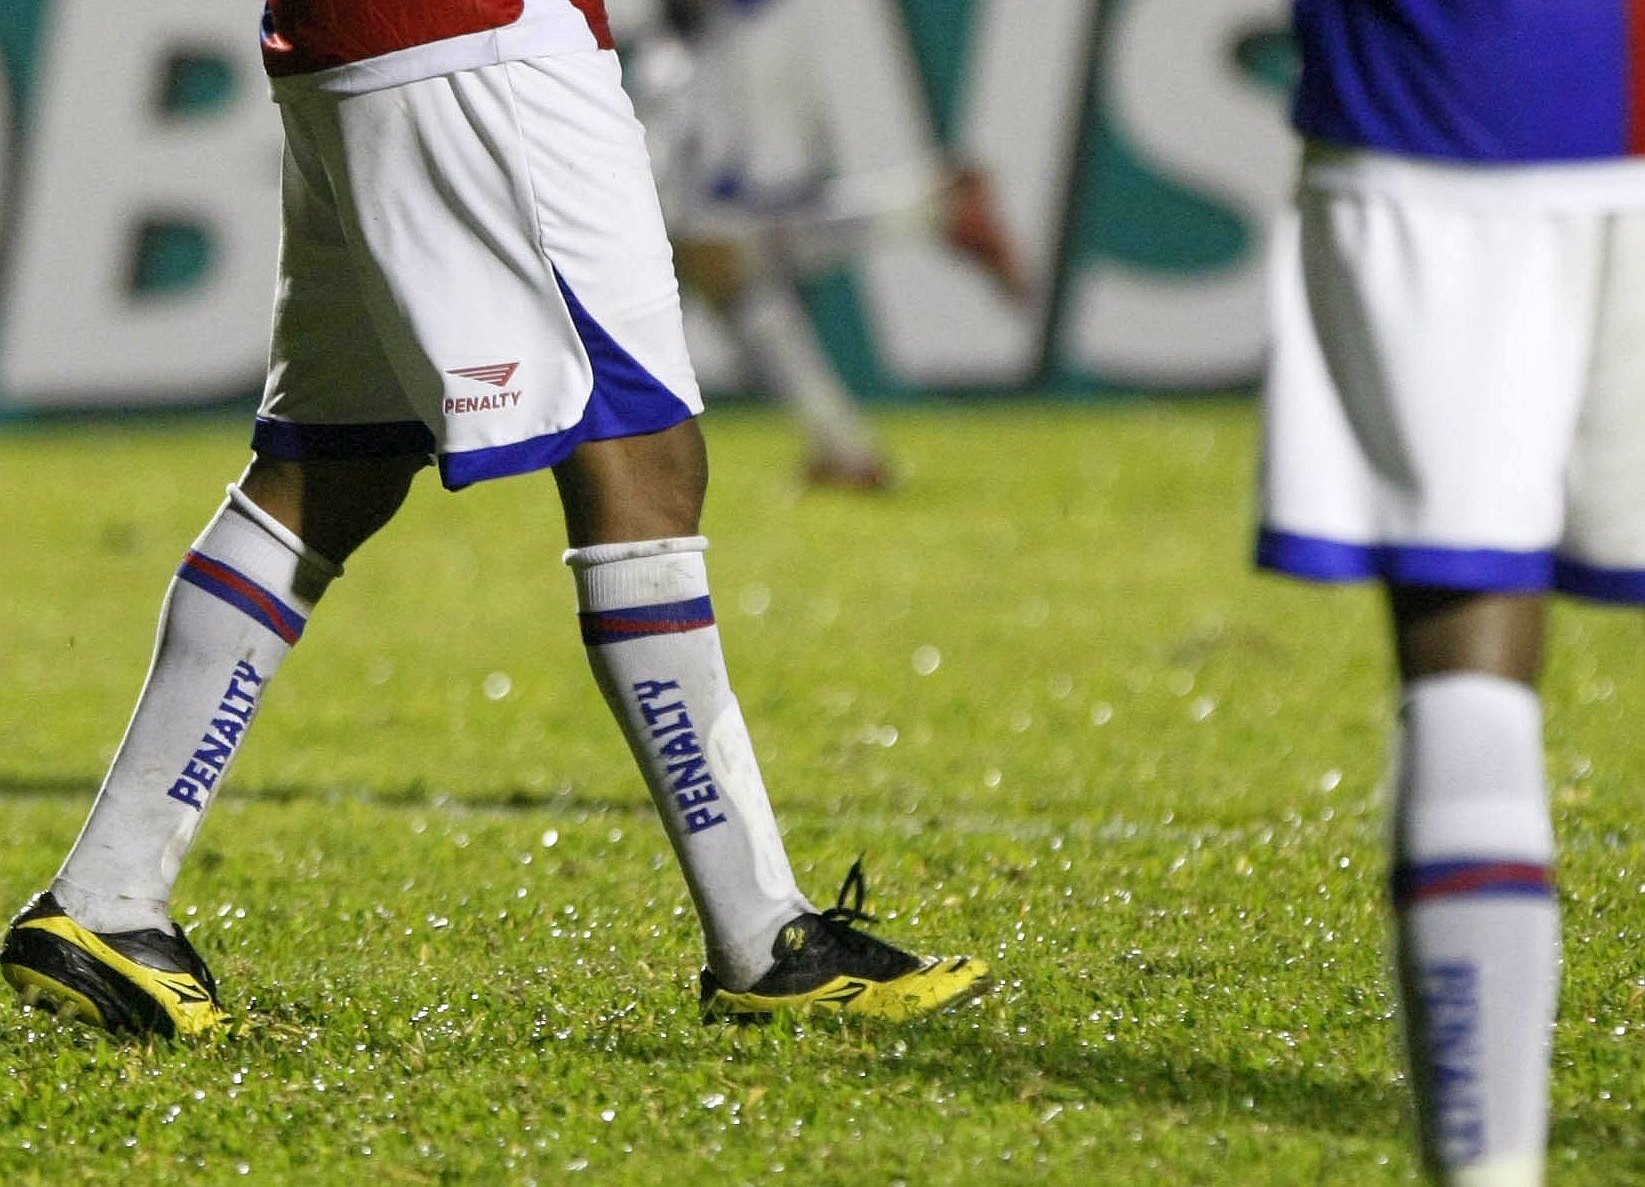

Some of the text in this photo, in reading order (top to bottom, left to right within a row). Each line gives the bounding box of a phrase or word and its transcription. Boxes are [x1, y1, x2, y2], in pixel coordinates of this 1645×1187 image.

[444, 391, 522, 414] PENALTY
[167, 660, 263, 812] PENALTY
[633, 680, 727, 834] PENALTY
